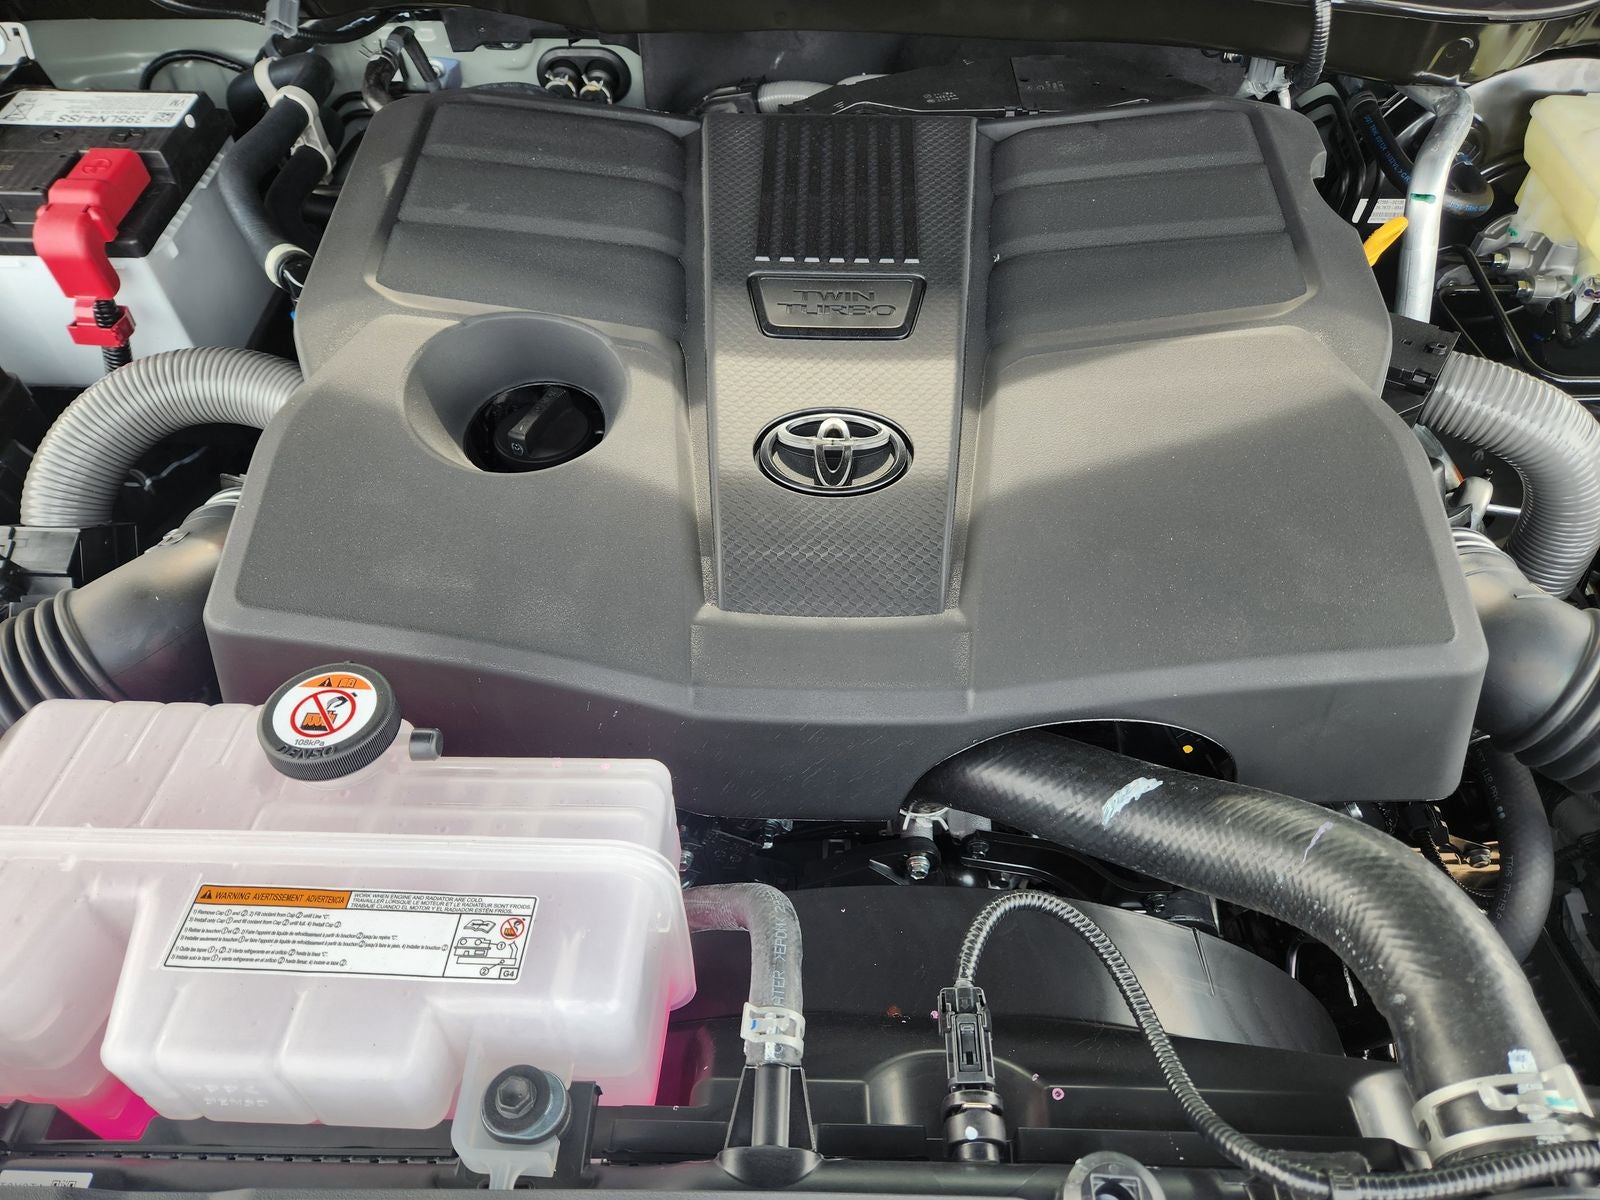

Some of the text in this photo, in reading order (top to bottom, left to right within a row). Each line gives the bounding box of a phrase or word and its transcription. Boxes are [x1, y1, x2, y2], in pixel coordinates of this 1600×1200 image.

[793, 289, 874, 302] TWIN
[777, 302, 896, 316] TURBO
[276, 745, 336, 760] DENSO
[215, 891, 345, 904] WARNING AVERTISSEMENT ADVERTENCIA
[502, 970, 515, 978] G4
[771, 969, 786, 1007] ATER
